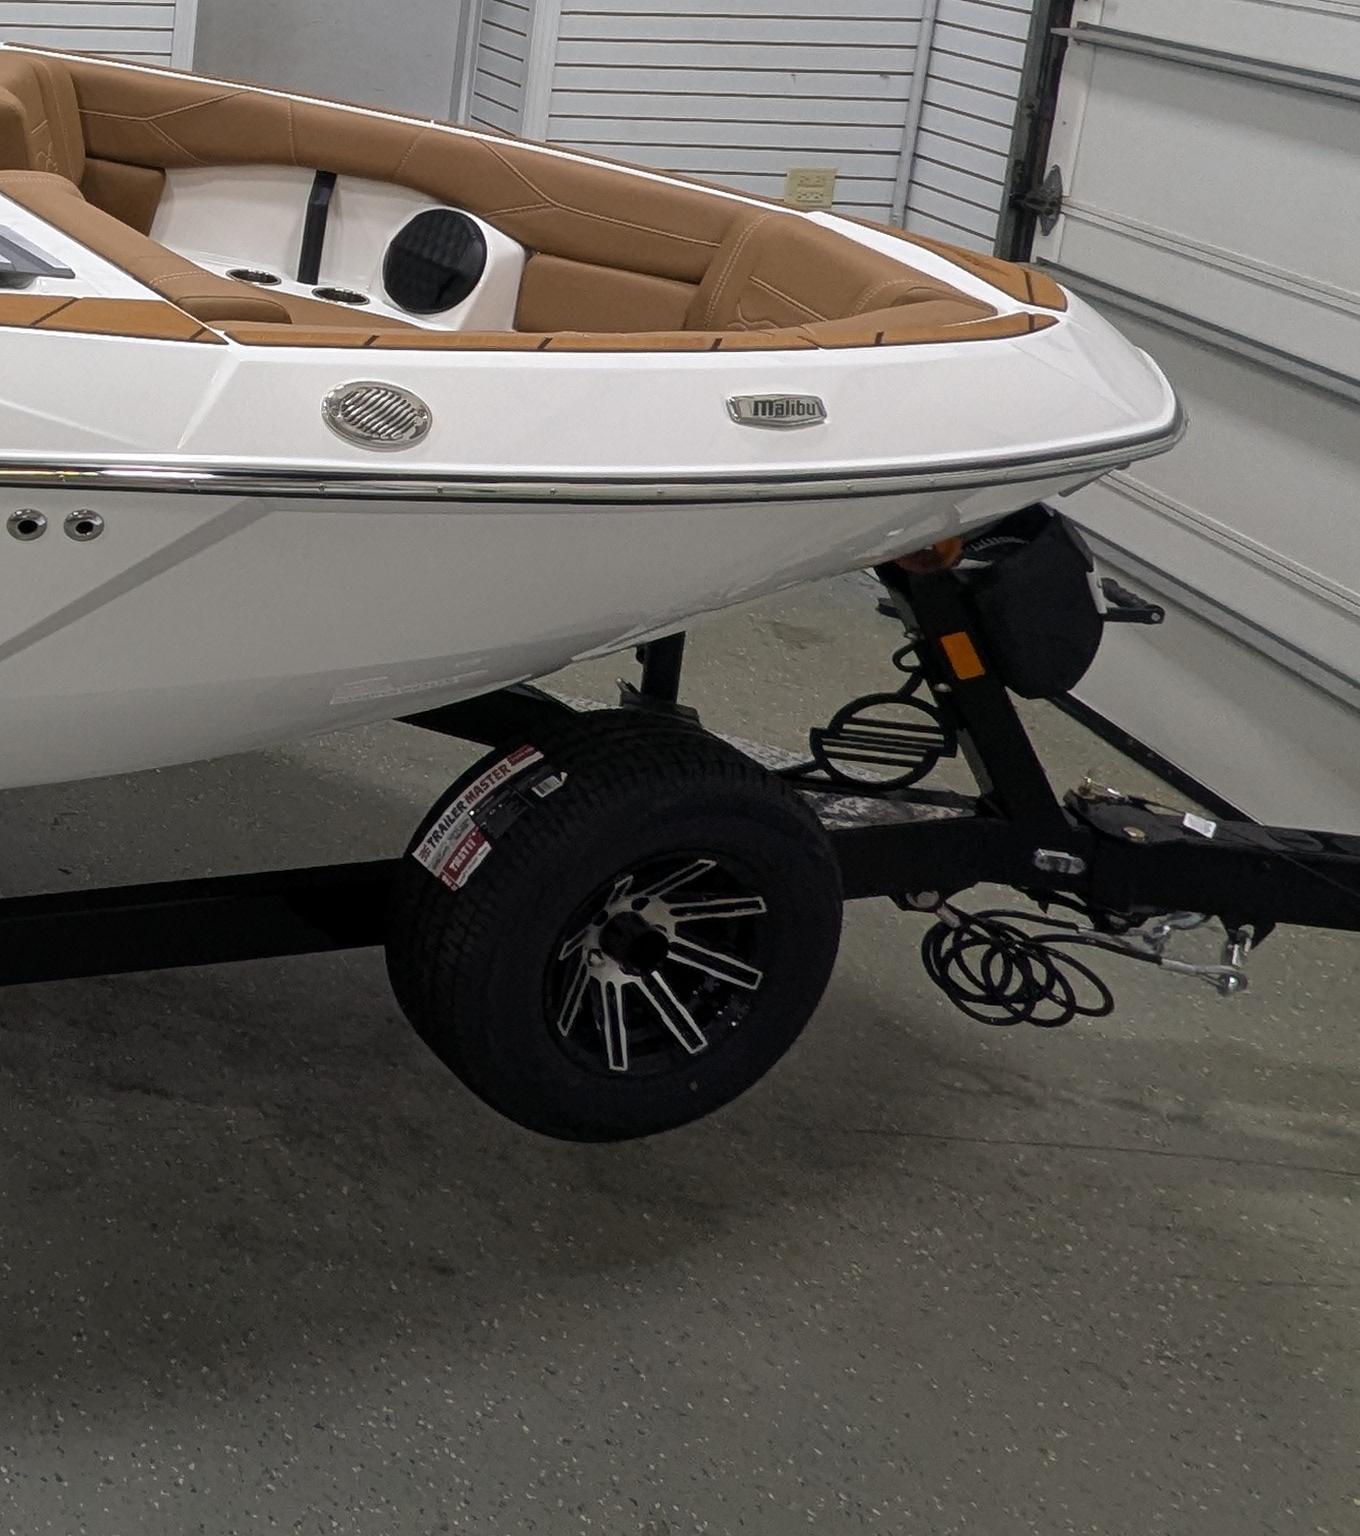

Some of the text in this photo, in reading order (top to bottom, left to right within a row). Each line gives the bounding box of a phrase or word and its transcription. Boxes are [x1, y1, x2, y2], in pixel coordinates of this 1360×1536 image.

[753, 400, 816, 417] Malibu
[428, 800, 468, 849] TRAILER
[464, 764, 511, 805] MASTER
